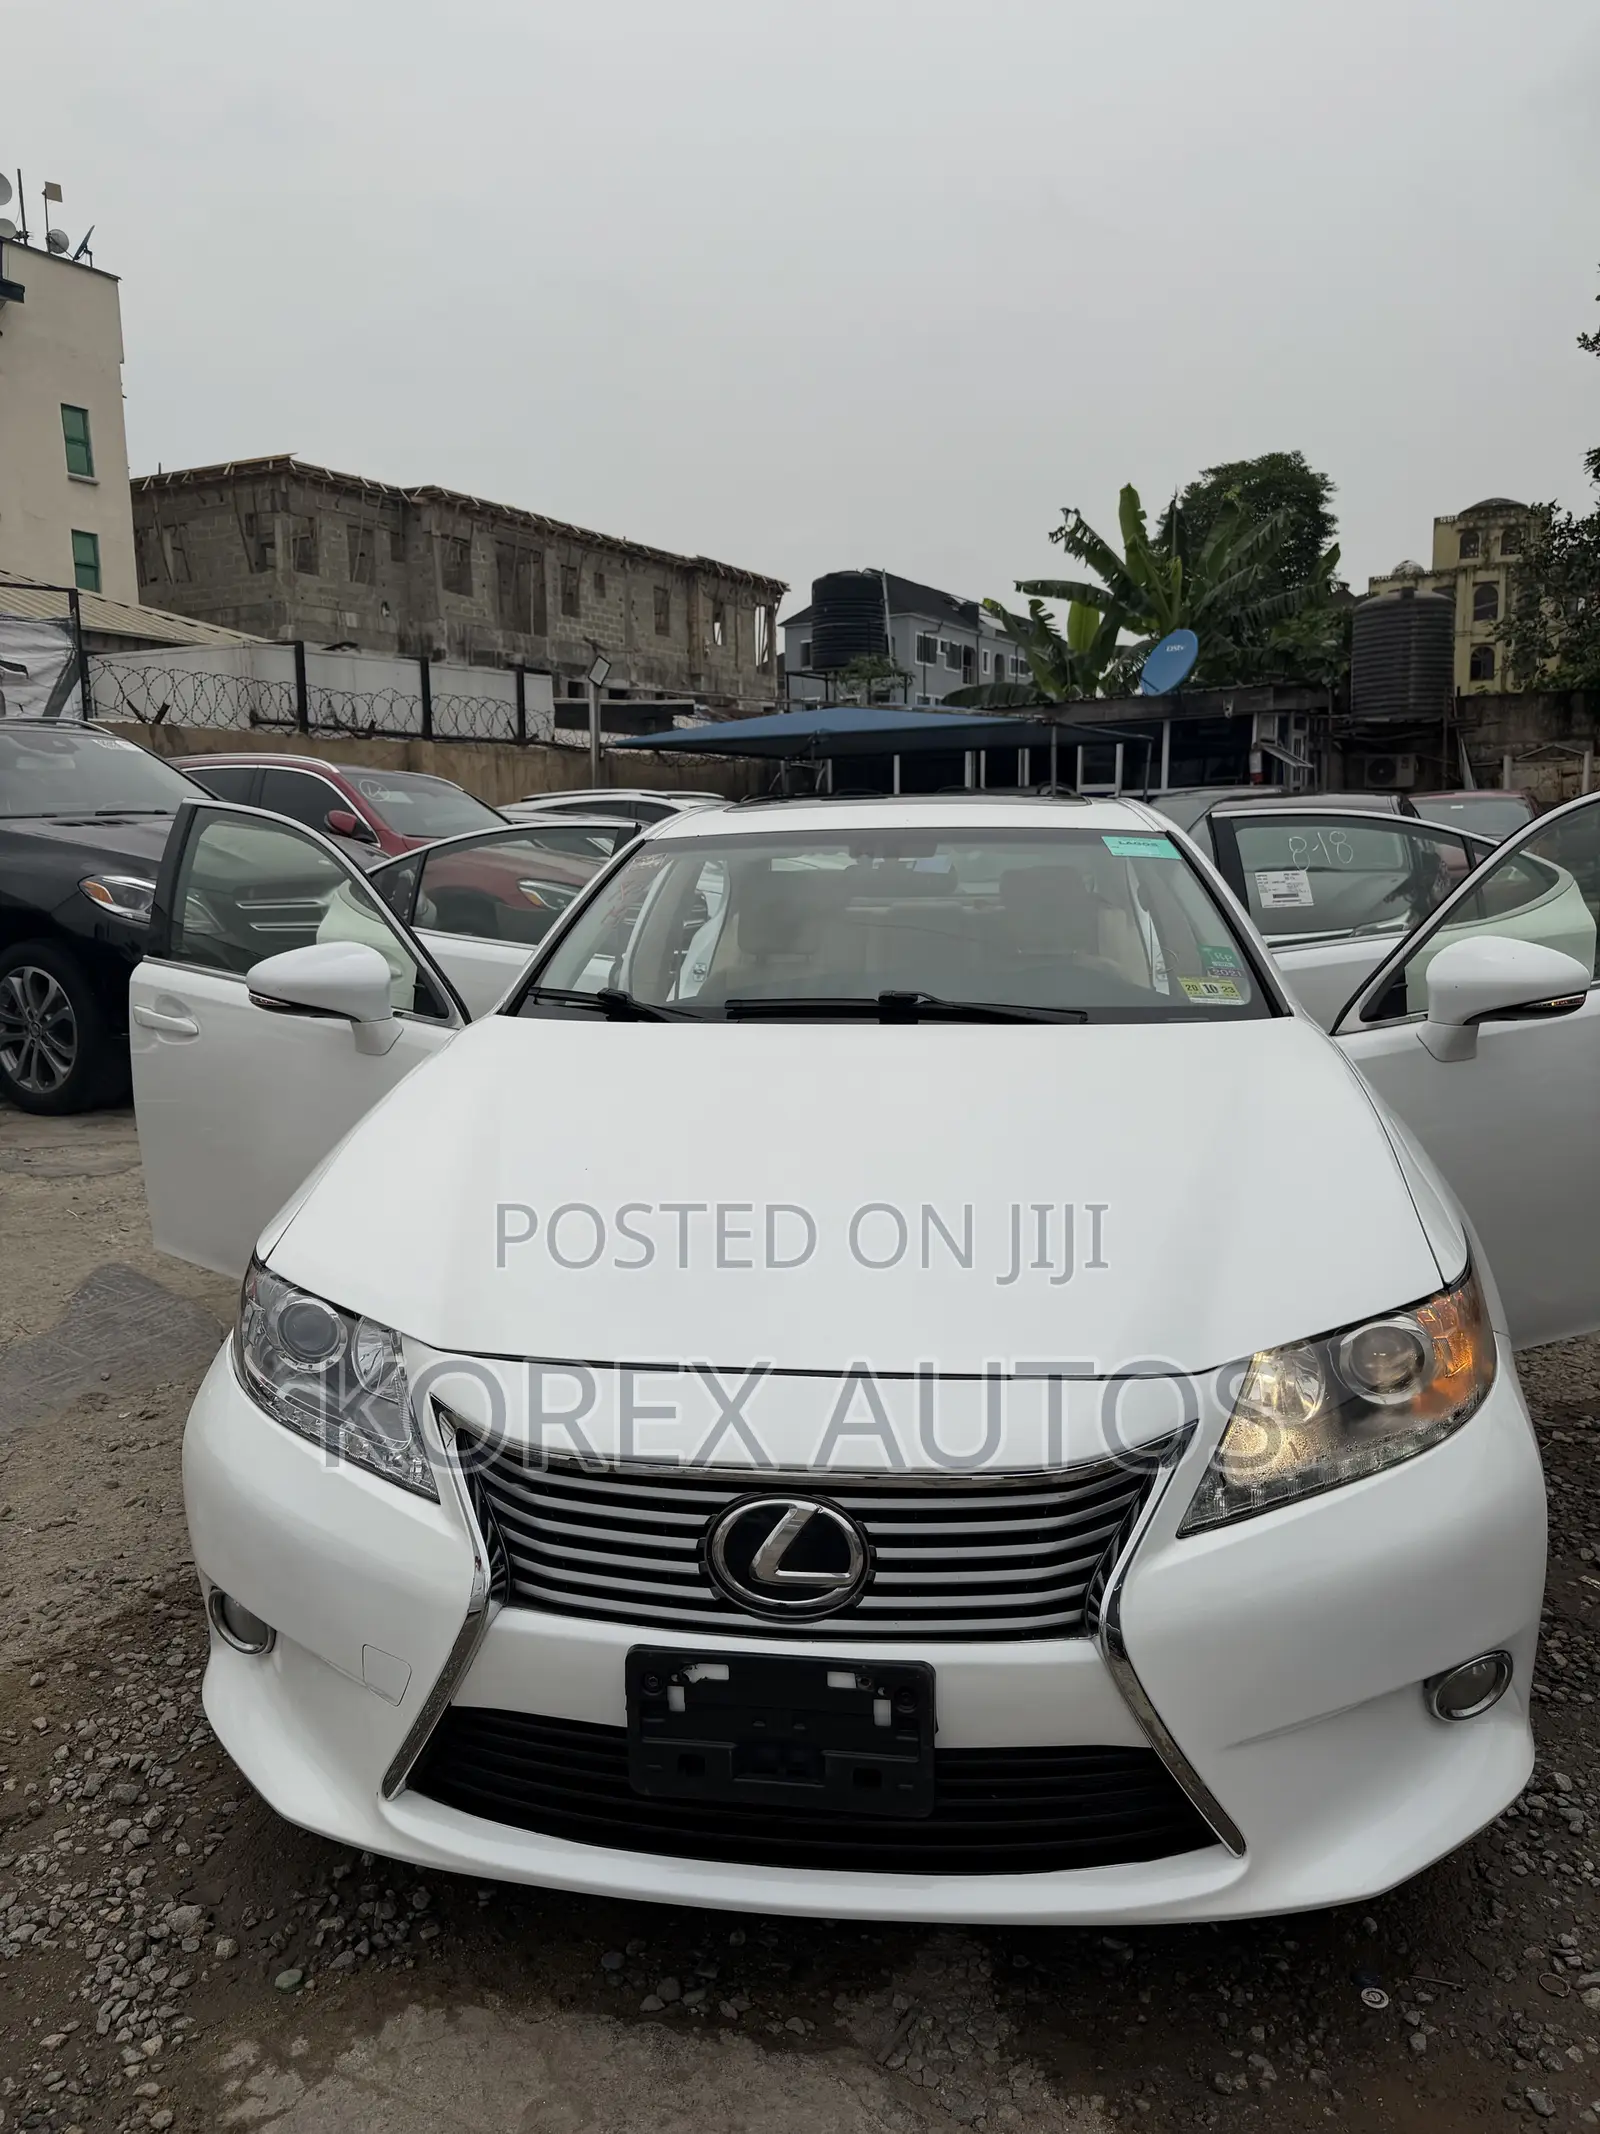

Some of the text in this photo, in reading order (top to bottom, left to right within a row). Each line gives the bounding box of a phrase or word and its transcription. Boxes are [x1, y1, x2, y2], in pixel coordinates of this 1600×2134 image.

[1184, 983, 1236, 994] 20 10 23
